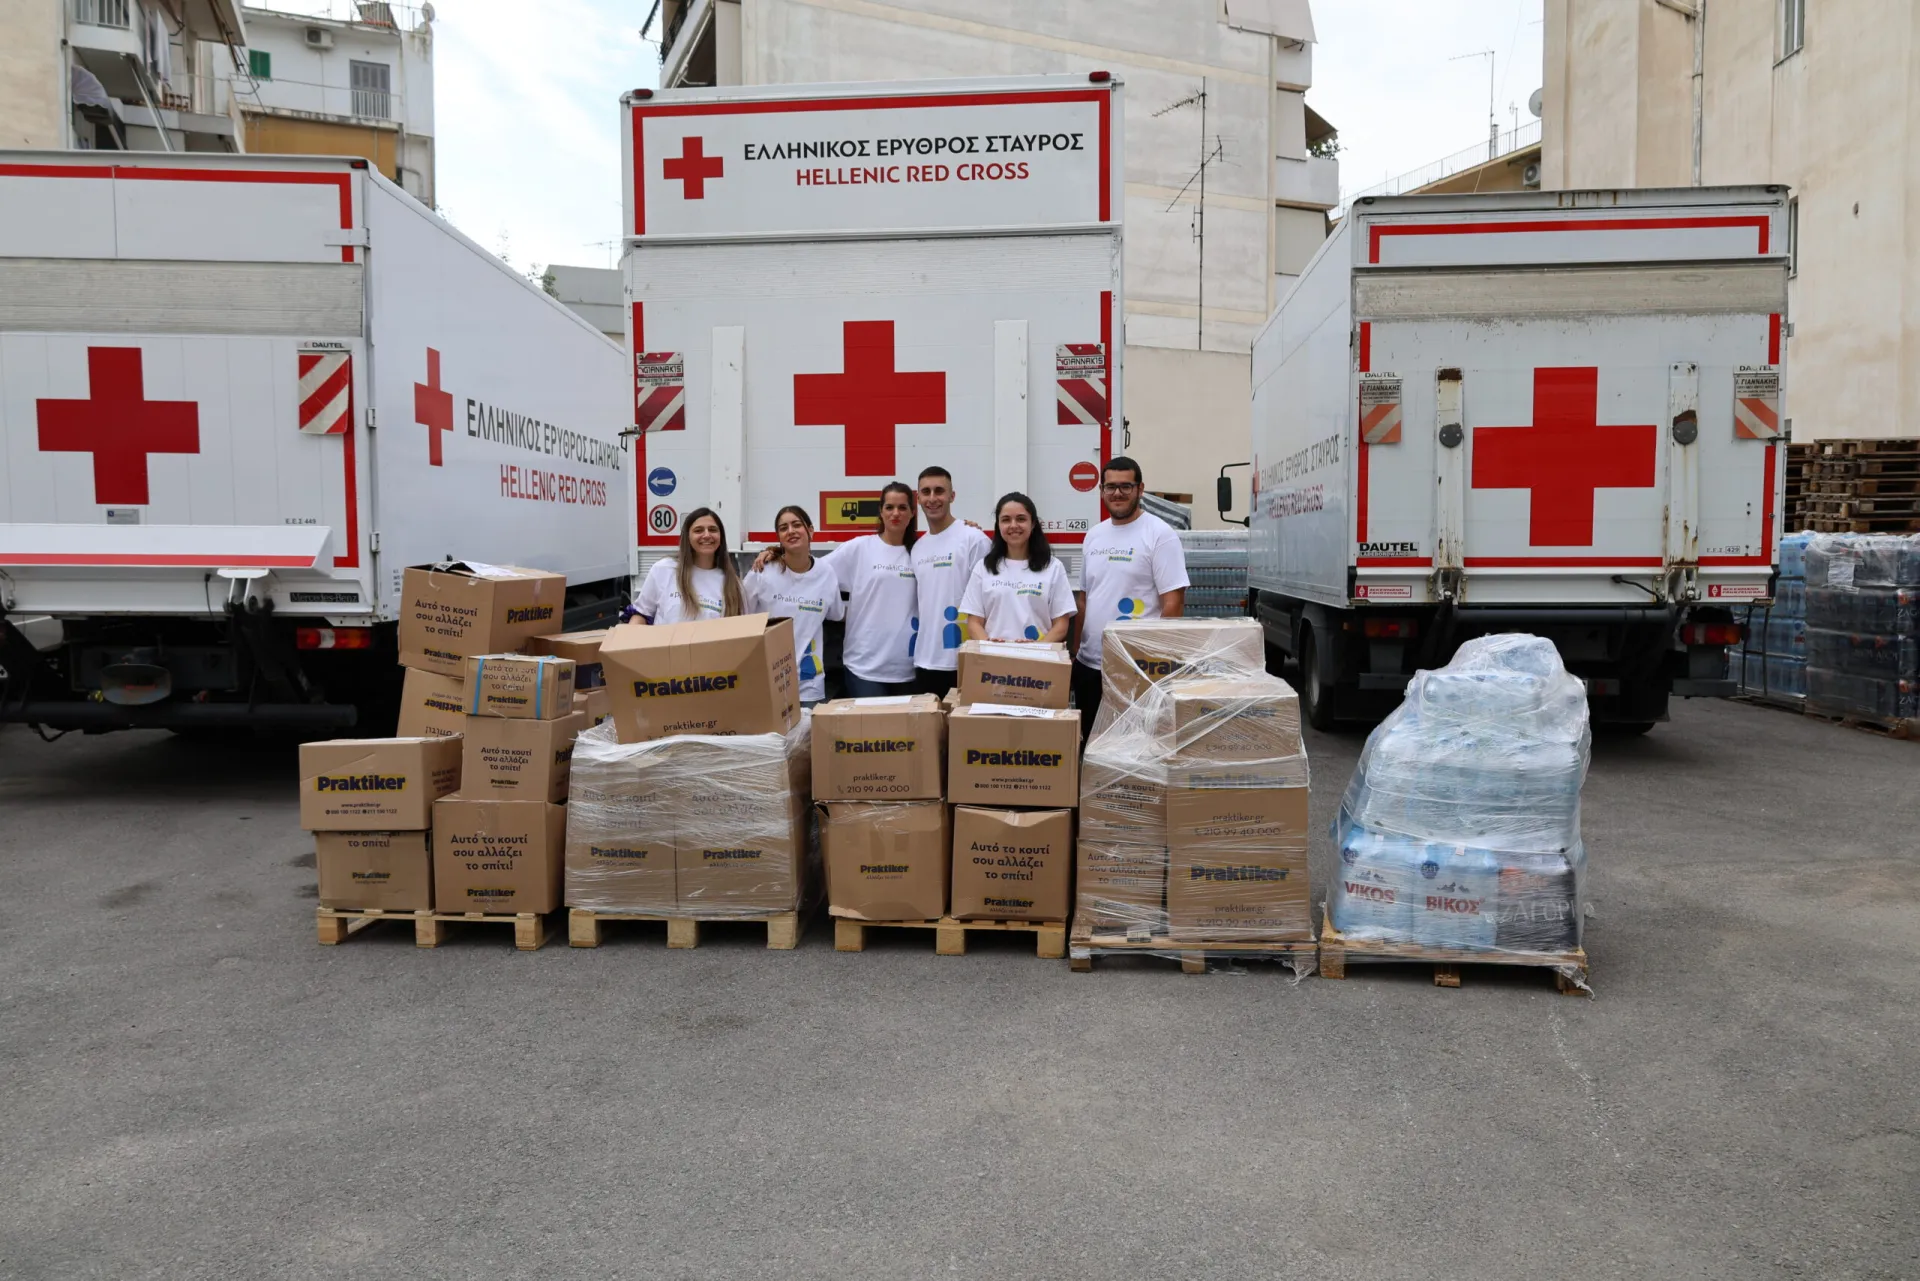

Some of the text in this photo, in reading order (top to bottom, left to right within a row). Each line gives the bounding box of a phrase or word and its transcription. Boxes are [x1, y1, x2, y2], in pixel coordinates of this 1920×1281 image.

[744, 133, 1084, 161] ΕΛΛΗΝΙΚΟΣ ΕΡΥΘΡΟΣ ΣΤΑΥΡΟΣ
[796, 162, 1029, 186] HELLENIC RED CROSS
[467, 398, 620, 471] ΕΛΛΗΝΙΚΟΣ ΕΡΥΘΡΟΣ ΣΤΑΥΡΟΣ
[1311, 433, 1339, 471] ΣΤΑΥΡΟΣ
[500, 463, 607, 507] HELLENIC RED CROSS
[654, 510, 672, 528] 80
[1068, 521, 1087, 530] 428
[1359, 542, 1418, 552] DAUTEL
[415, 599, 478, 617] Αυτό το κουτί
[416, 612, 472, 629] σου αλλάζει
[506, 606, 554, 624] Praktiker
[424, 624, 463, 638] το σπίτι!
[423, 648, 463, 662] Praktiker
[634, 675, 738, 697] Praktiker
[981, 671, 1052, 690] Praktiker
[487, 695, 528, 705] Praktiker
[663, 720, 718, 733] praktiker.gr
[511, 749, 532, 757] κουτί
[835, 740, 915, 753] Praktiker
[499, 756, 529, 765] αλλάζει
[967, 749, 1062, 767] Praktiker
[499, 764, 521, 772] σπίτι!
[317, 775, 406, 792] Praktiker
[853, 773, 897, 782] praktiker.gr
[847, 785, 910, 793] 210 99 40 000
[1131, 783, 1156, 792] κουτί
[1212, 812, 1265, 823] praktiker.gr
[450, 833, 528, 844] Αυτό το κουτί
[1204, 828, 1221, 836] 210
[1223, 828, 1237, 836] 99
[1240, 828, 1254, 836] 40
[348, 837, 391, 848] το σπίτι!
[971, 841, 1000, 853] Αυτό
[1019, 844, 1050, 855] κουτί
[453, 846, 523, 859] σου αλλάζει
[591, 846, 649, 859] Praktiker
[703, 849, 762, 860] Praktiker
[465, 860, 513, 870] το σπίτι!
[860, 864, 909, 873] Praktiker
[972, 856, 1044, 869] σου αλλάζει
[985, 871, 1033, 881] το σπίτι!
[1191, 865, 1290, 881] Praktiker
[467, 888, 516, 897] Praktiker
[1344, 881, 1396, 904] VIKOS
[984, 897, 1034, 908] Praktiker
[1426, 895, 1480, 915] ΒΙΚΟΣ
